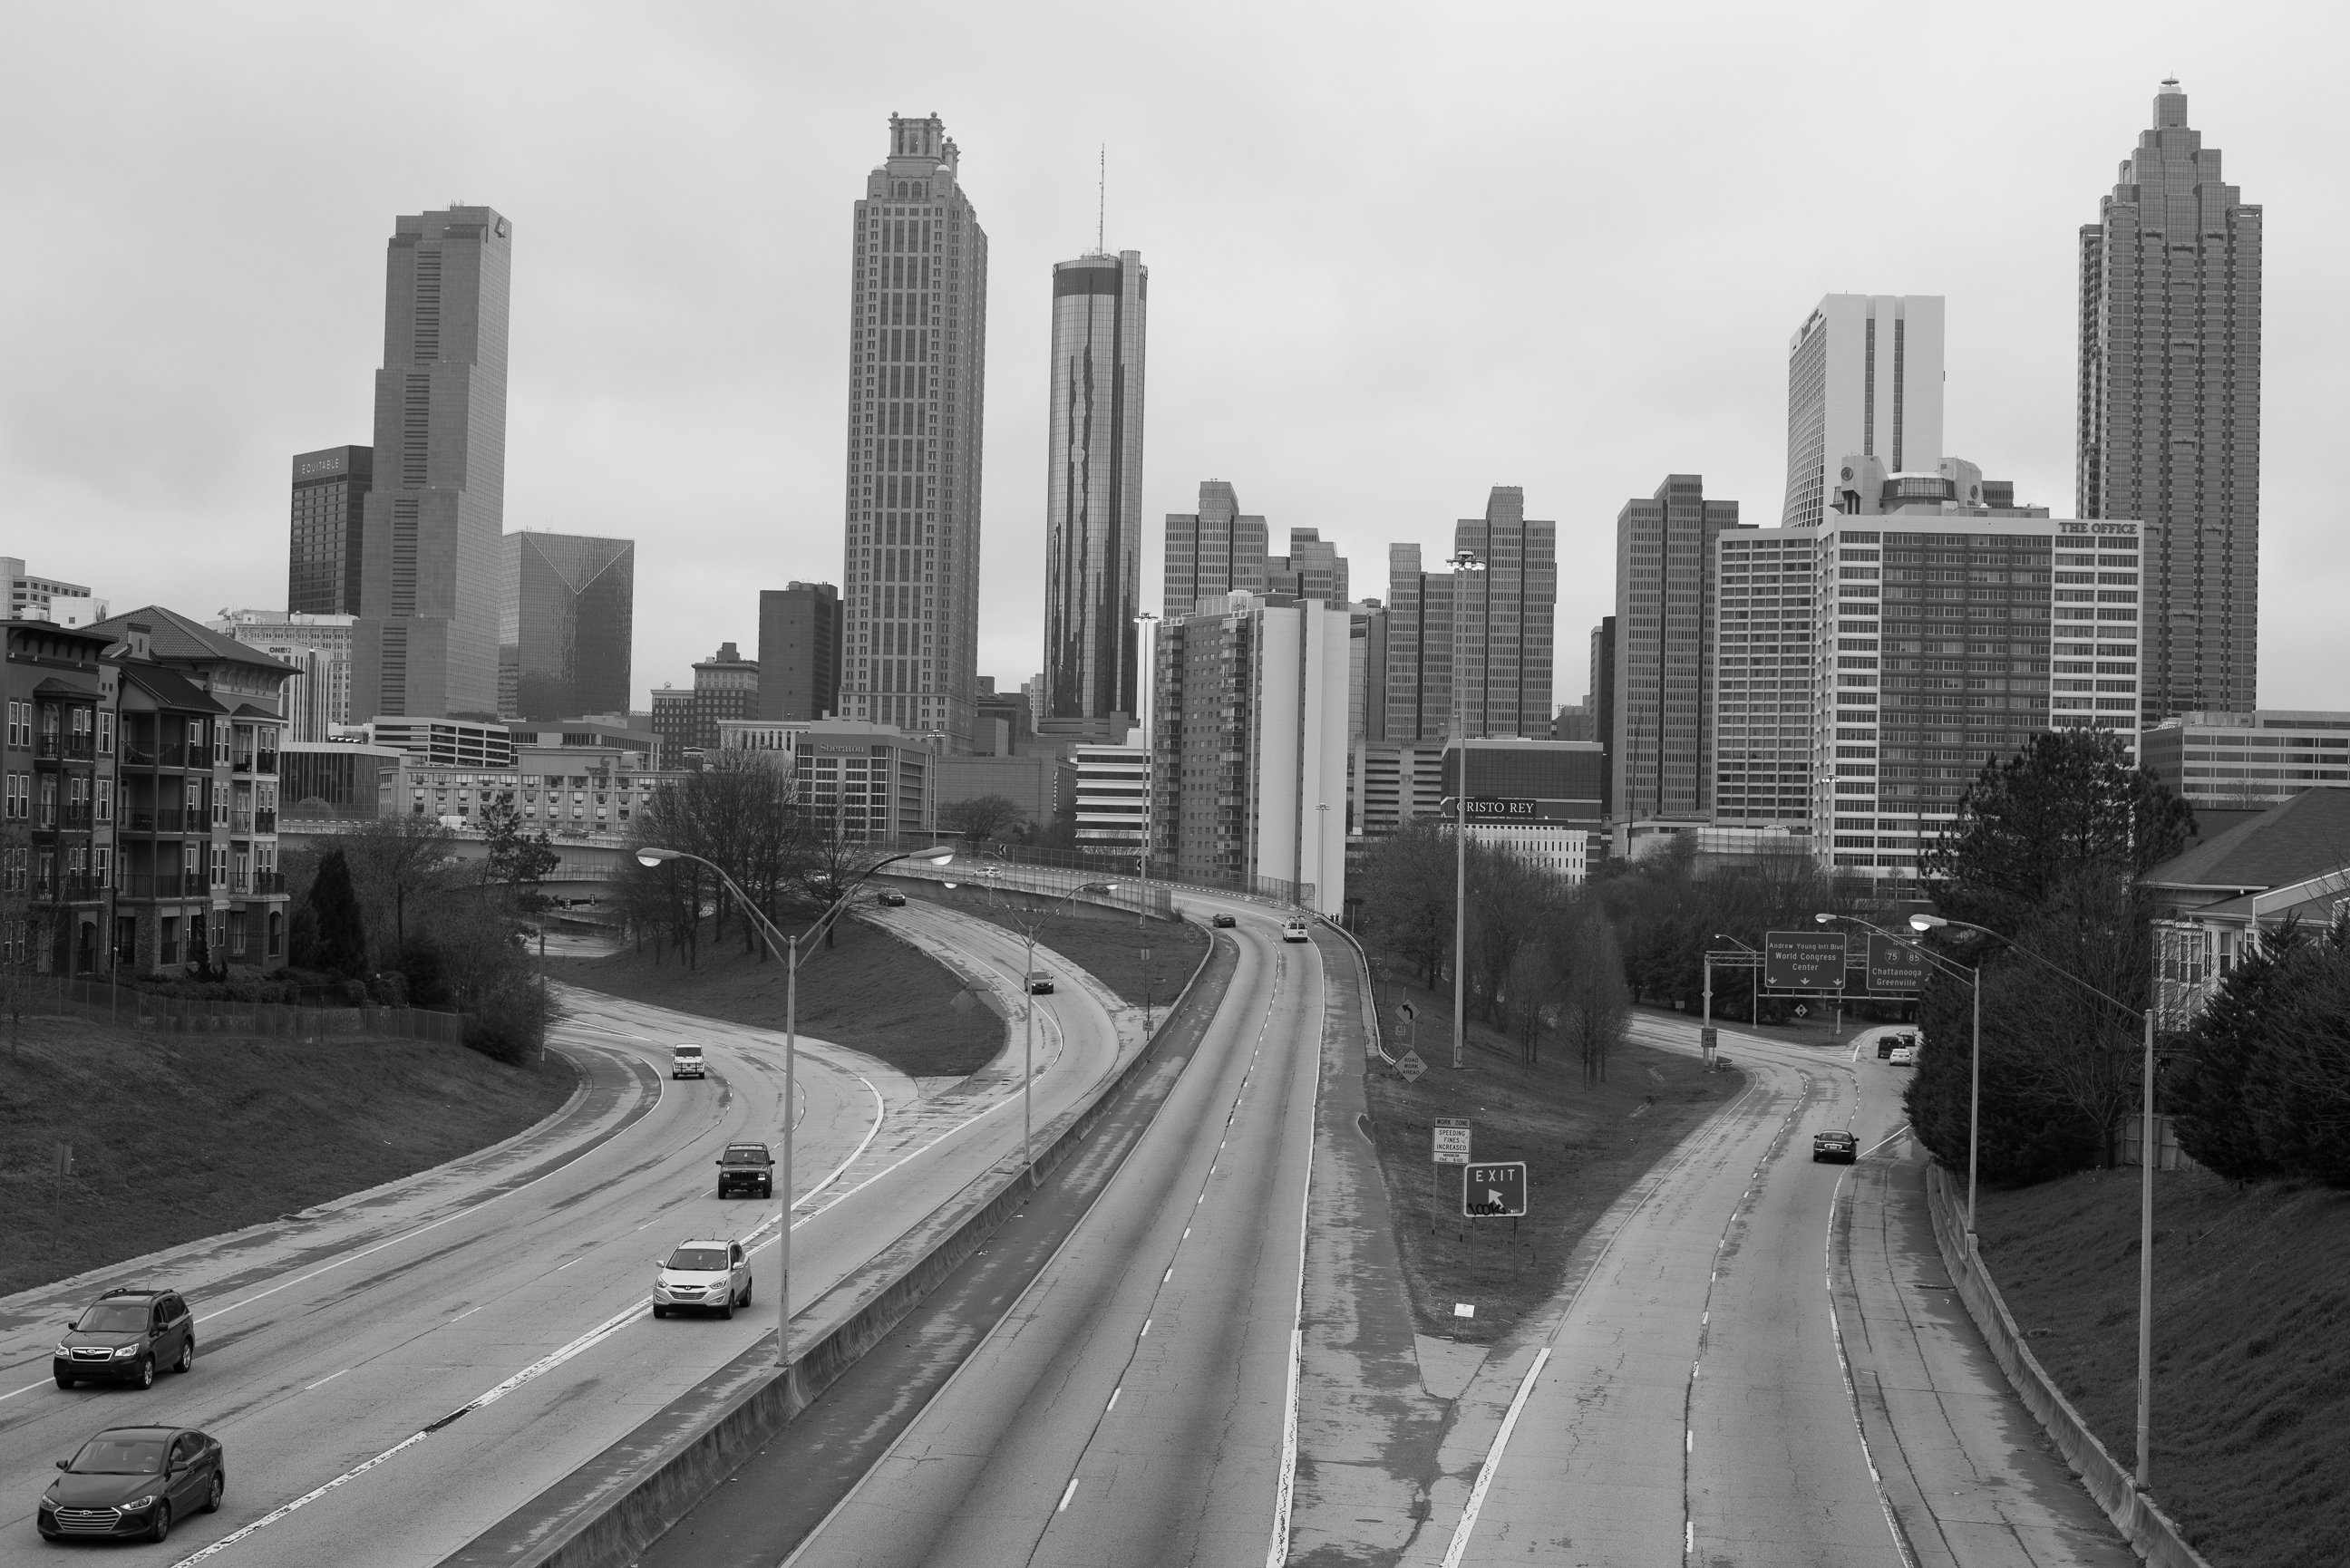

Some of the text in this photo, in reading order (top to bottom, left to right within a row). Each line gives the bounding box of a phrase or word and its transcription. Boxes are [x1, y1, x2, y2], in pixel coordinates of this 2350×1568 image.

[302, 458, 339, 474] EQUITABLE
[2059, 522, 2138, 534] THE OFFICE
[820, 743, 864, 753] Sheraton
[1510, 803, 1534, 813] REY
[1796, 943, 1816, 951] Young
[1775, 952, 1836, 963] World Congress
[1872, 967, 1922, 978] Chattanooga
[1877, 978, 1917, 986] Greenville
[1476, 1169, 1515, 1182] EXIT
